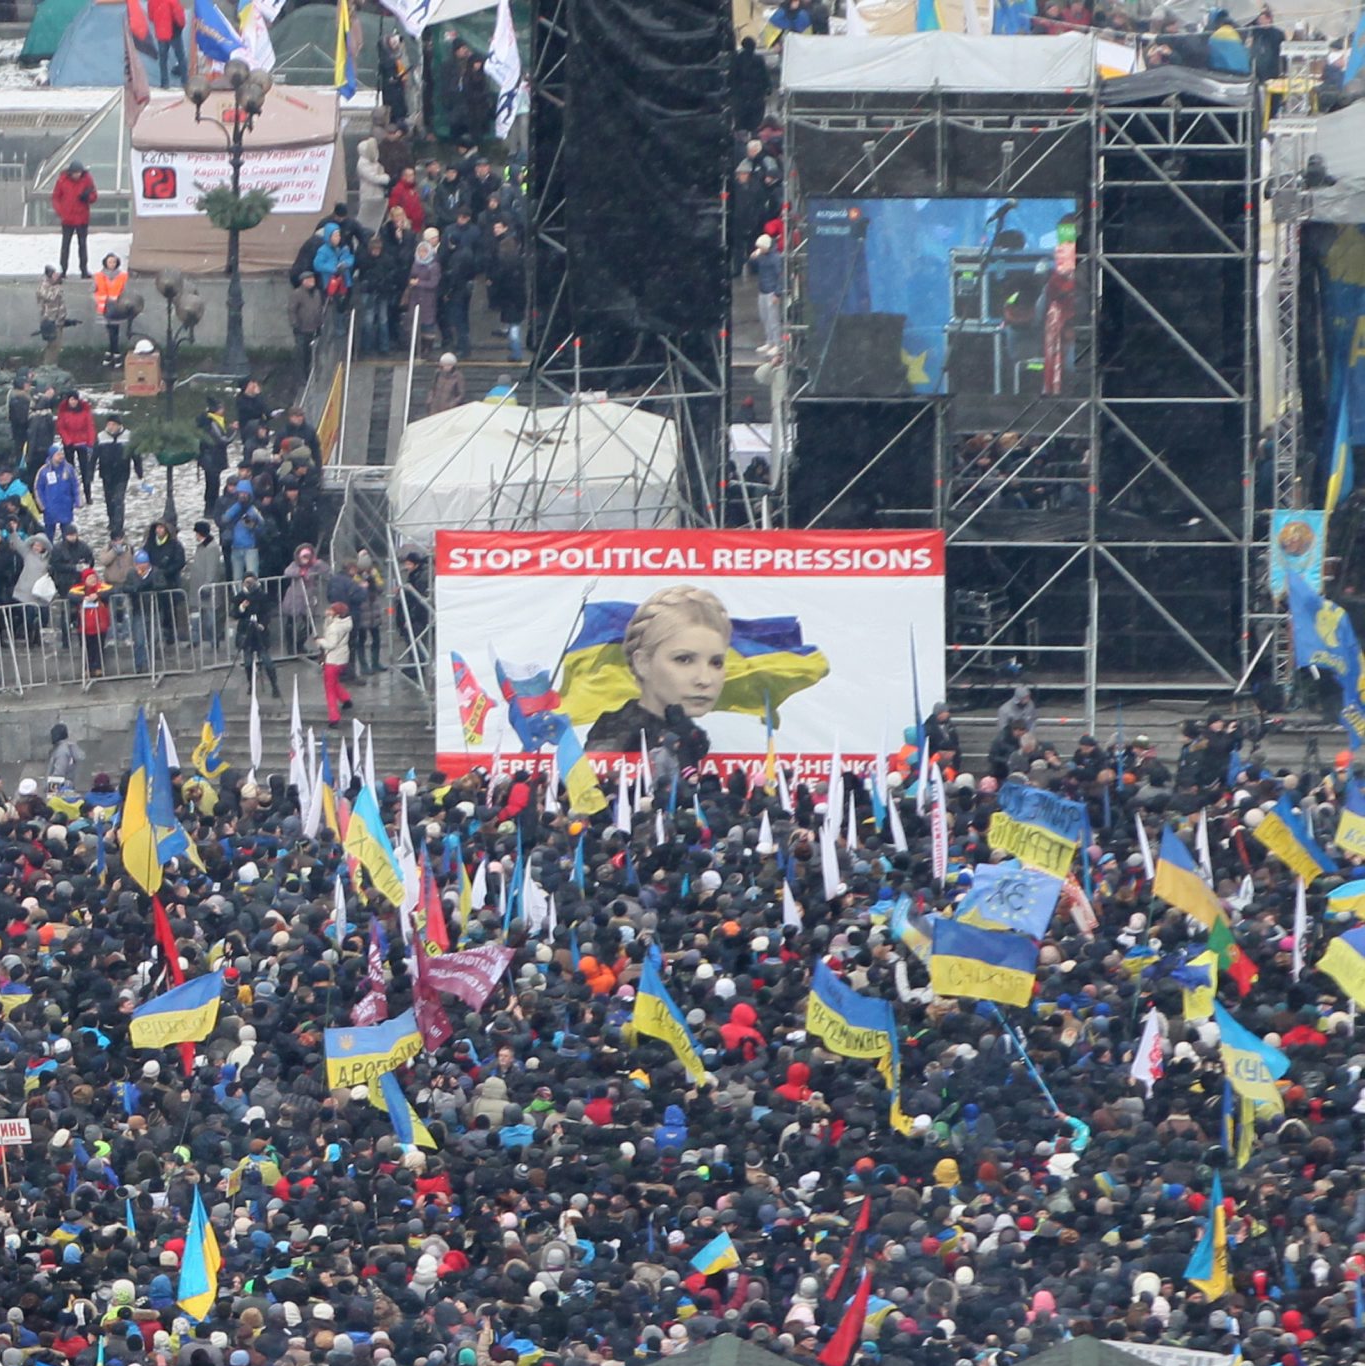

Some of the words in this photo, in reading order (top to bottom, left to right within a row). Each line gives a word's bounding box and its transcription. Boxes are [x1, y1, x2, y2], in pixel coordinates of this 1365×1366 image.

[449, 548, 531, 571] STOP
[540, 548, 706, 571] POLITICAL
[714, 548, 932, 571] REPRESSIONS
